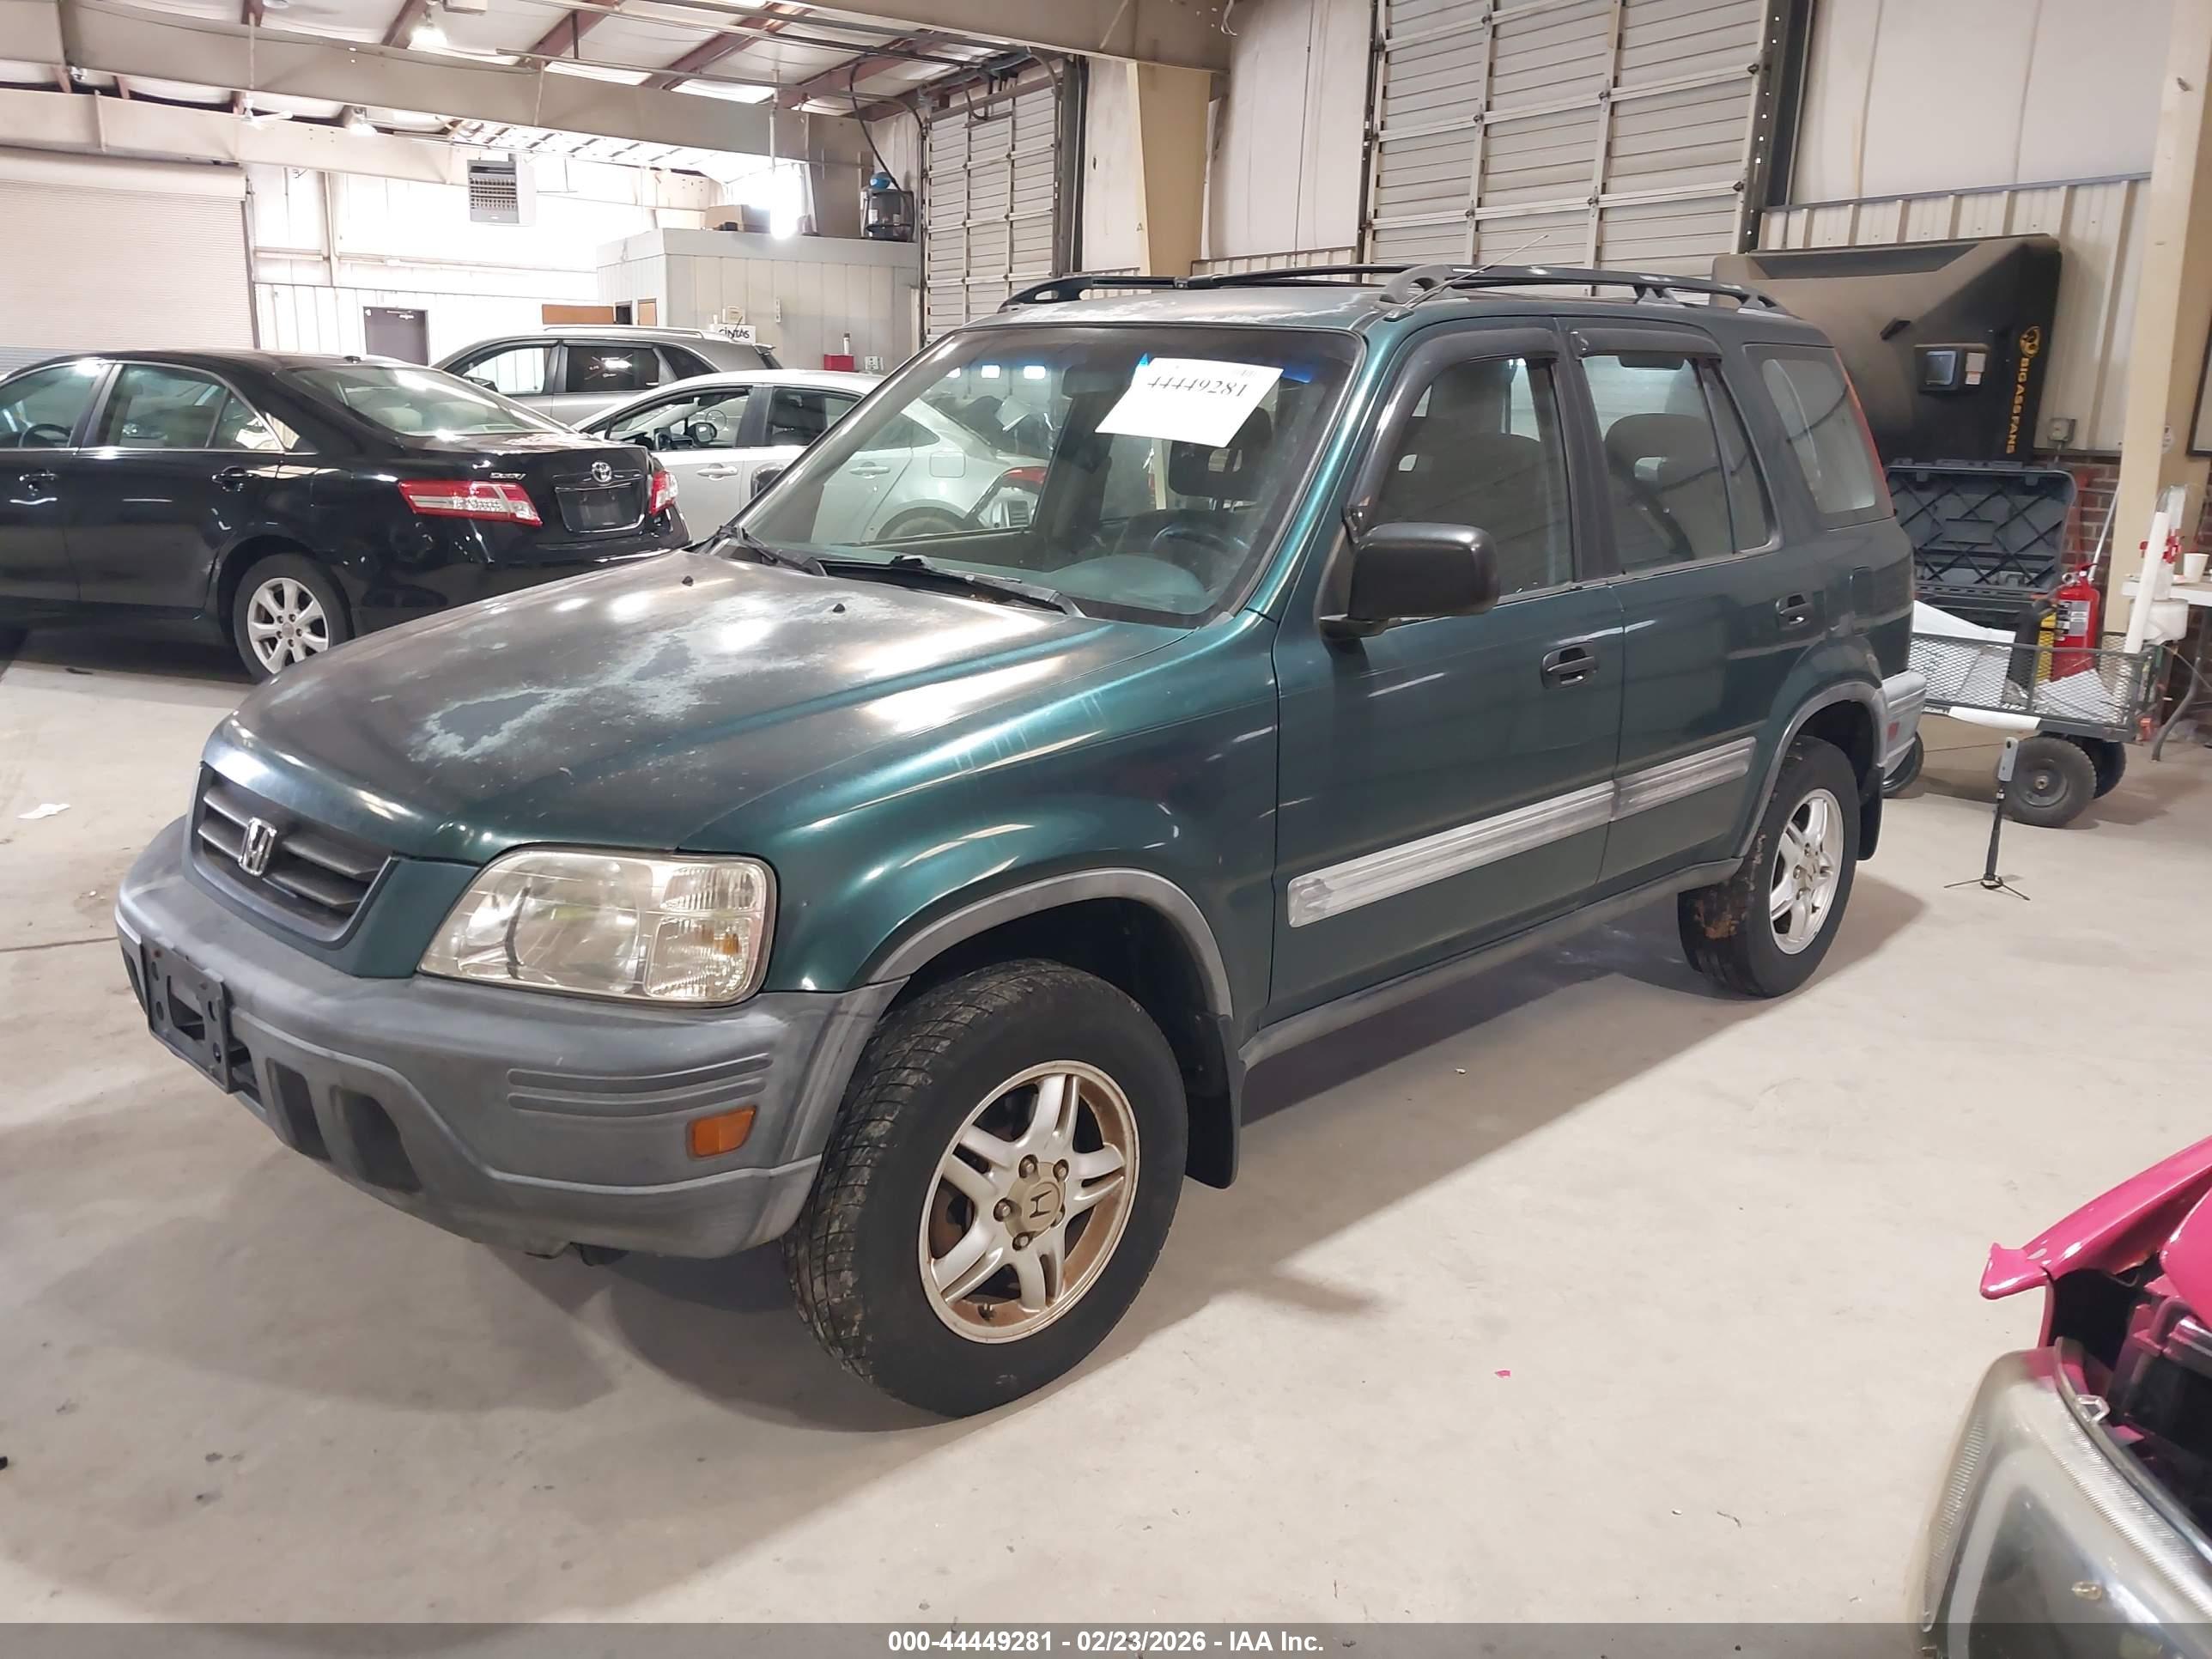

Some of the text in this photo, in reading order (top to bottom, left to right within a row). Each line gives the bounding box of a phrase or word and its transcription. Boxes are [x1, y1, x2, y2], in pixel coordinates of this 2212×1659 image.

[1147, 376, 1248, 398] 44449281
[2006, 357, 2030, 454] BIG ASS FANS
